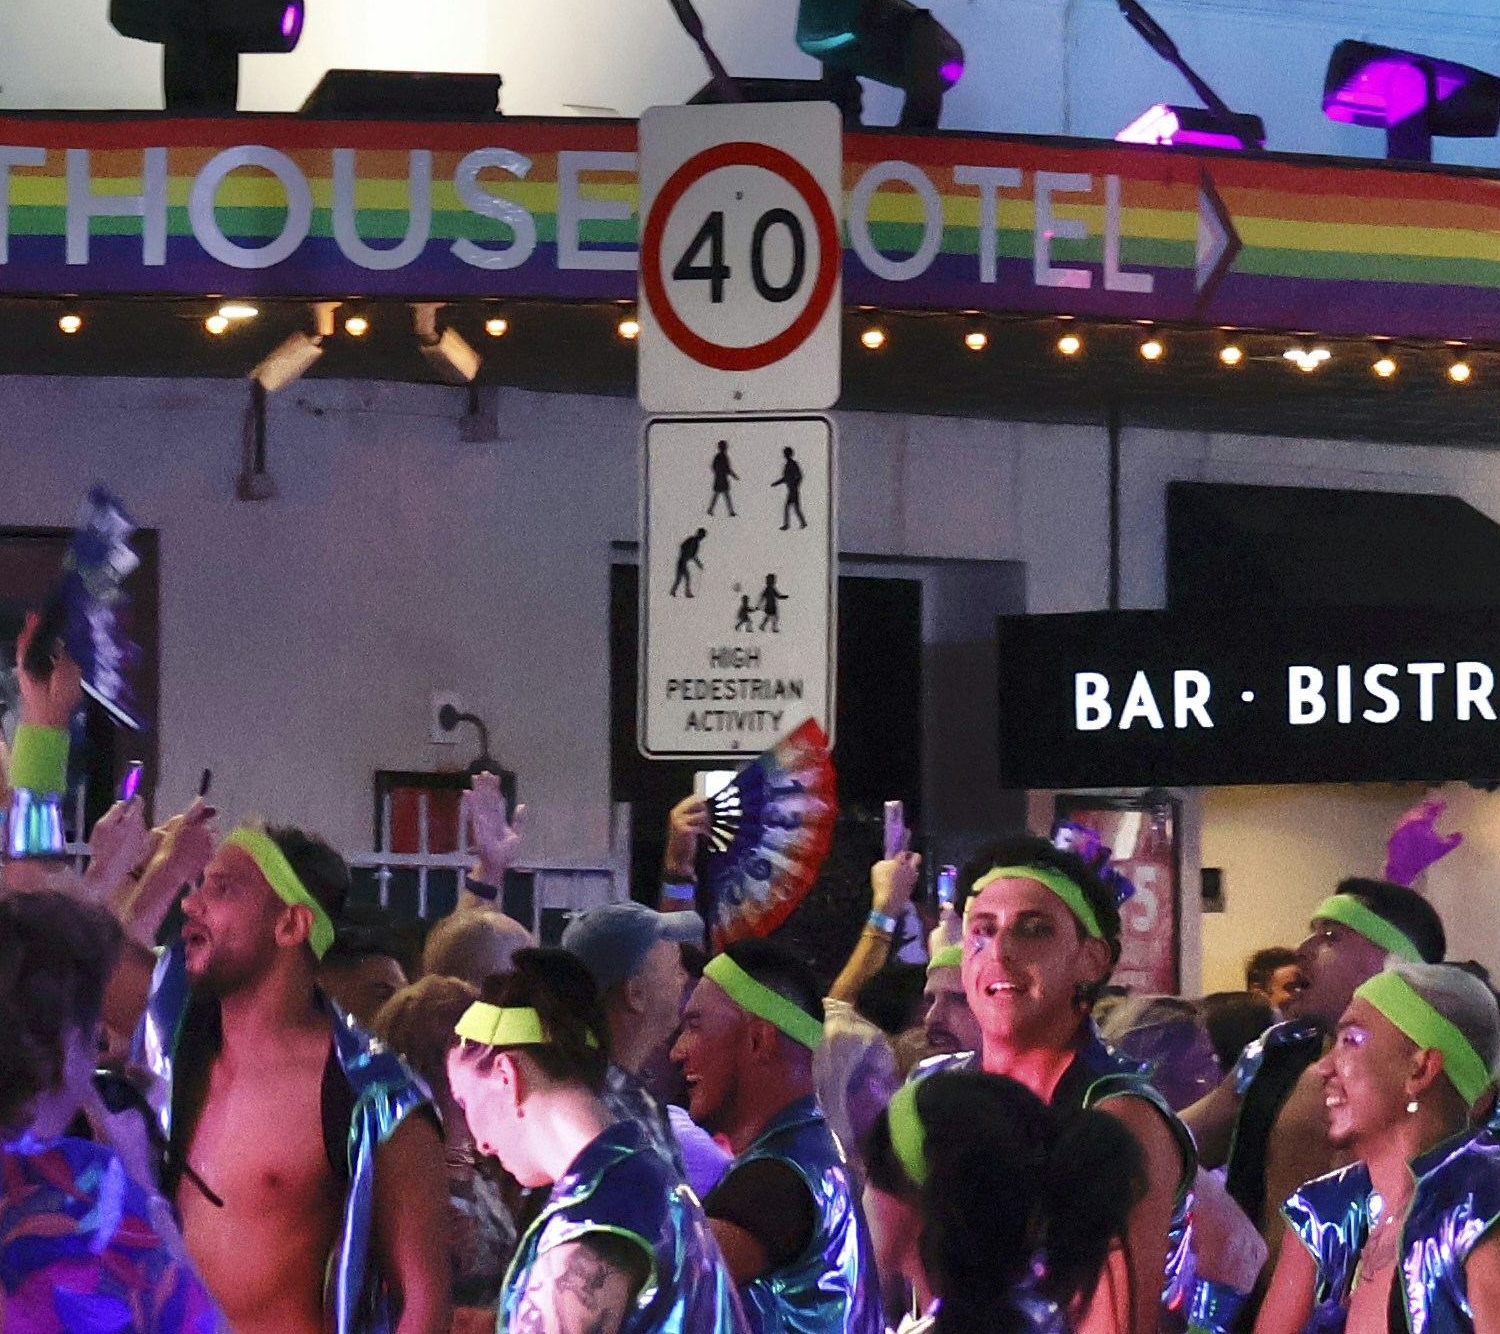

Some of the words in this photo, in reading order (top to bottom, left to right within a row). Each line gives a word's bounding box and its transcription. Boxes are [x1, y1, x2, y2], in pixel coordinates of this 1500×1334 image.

[850, 160, 1155, 296] OTEL
[672, 207, 808, 304] 40
[708, 646, 762, 670] HIGH
[666, 677, 804, 703] PEDESTRIAN
[1073, 669, 1216, 732] BAR
[684, 708, 786, 734] ACTIVITY
